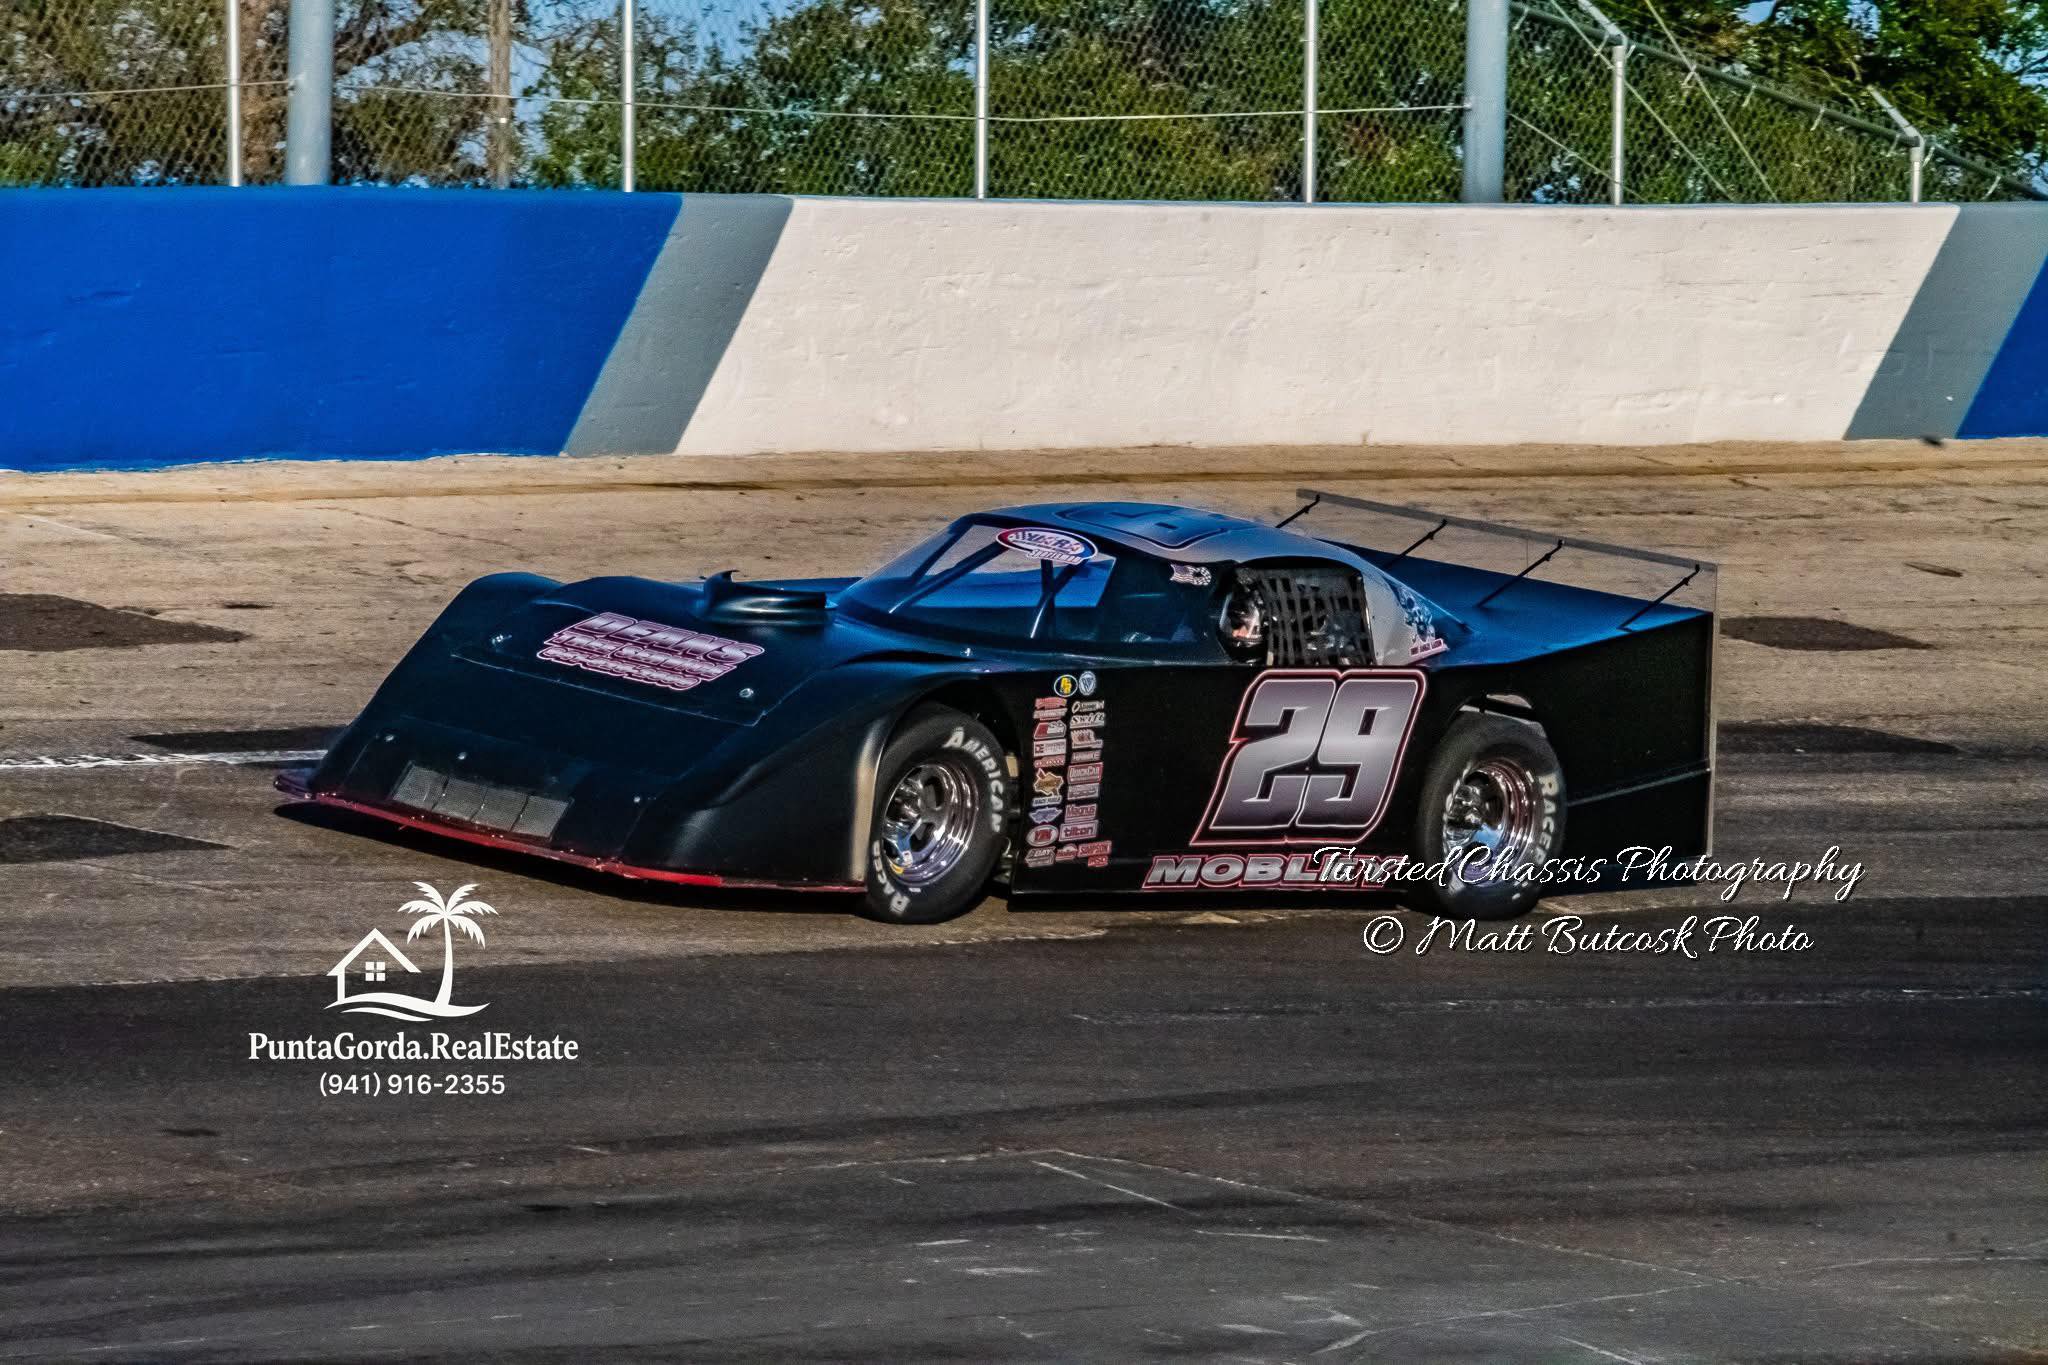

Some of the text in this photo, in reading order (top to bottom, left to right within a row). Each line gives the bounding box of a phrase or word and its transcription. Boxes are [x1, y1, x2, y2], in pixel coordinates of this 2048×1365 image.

[556, 612, 765, 664] DEANS
[1200, 673, 1423, 838] 29
[1064, 826, 1093, 837] tilton
[1535, 773, 1560, 865] RACER
